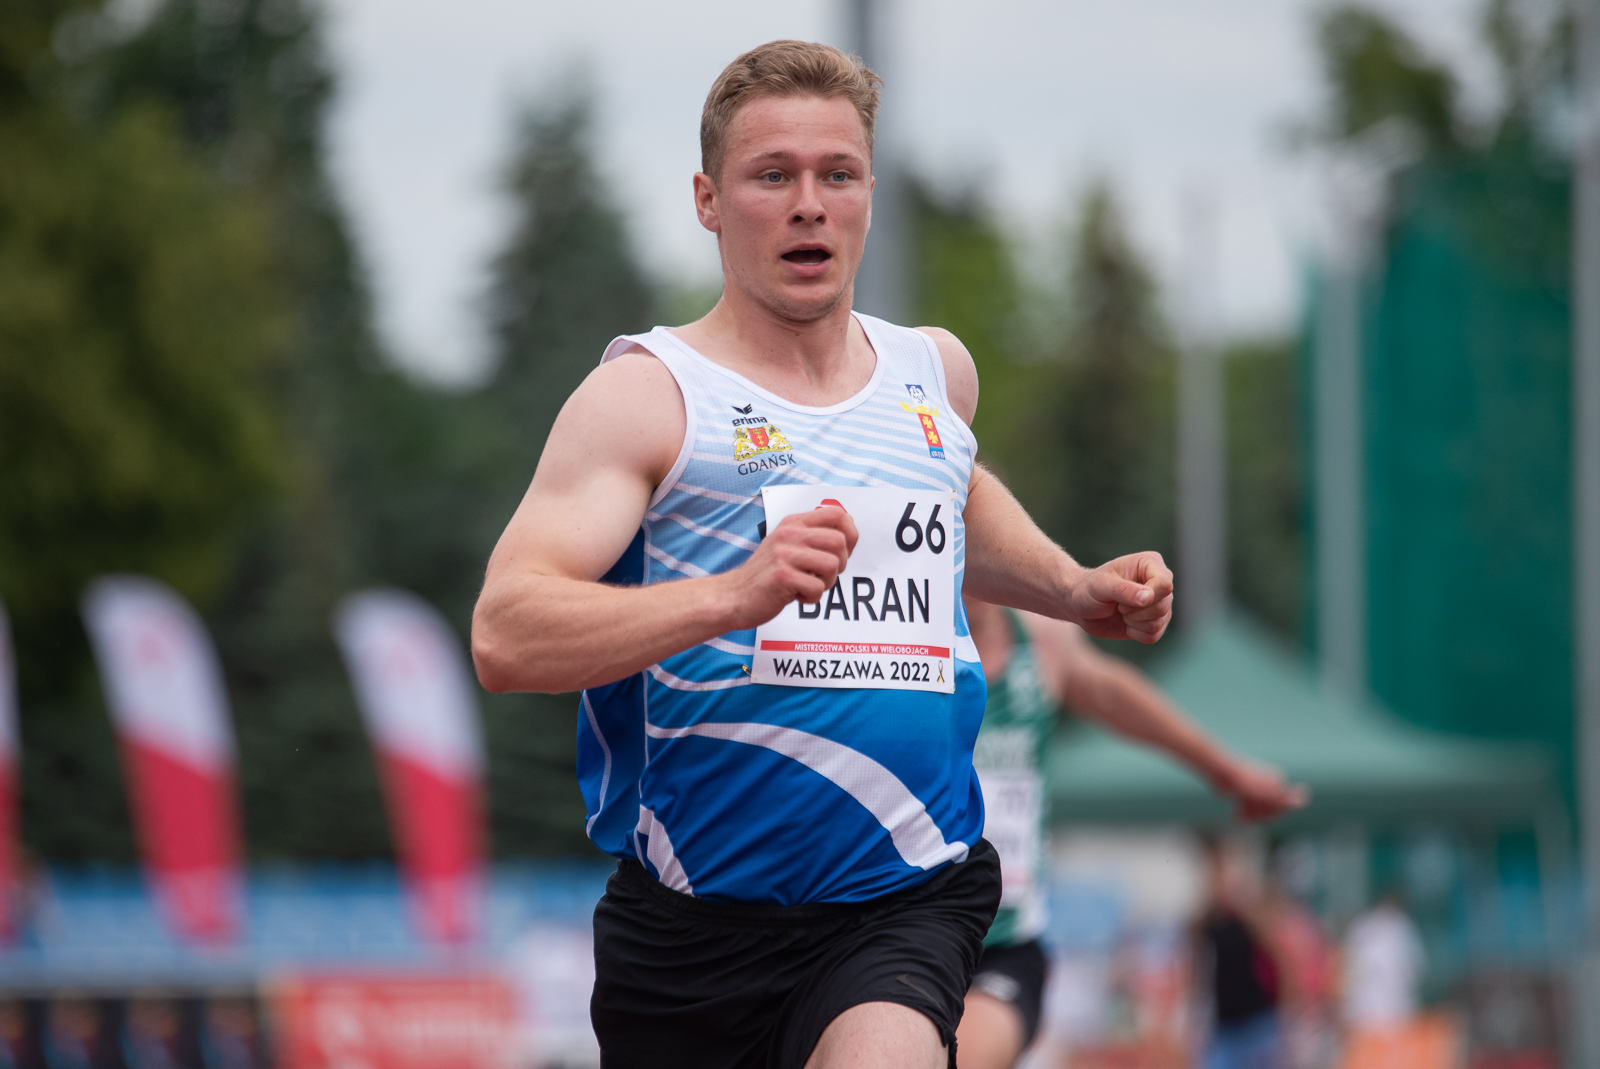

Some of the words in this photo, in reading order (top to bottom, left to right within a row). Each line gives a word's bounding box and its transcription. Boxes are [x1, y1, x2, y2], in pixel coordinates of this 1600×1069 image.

[732, 416, 768, 427] erima
[738, 454, 796, 476] GDAŃSK
[895, 502, 946, 555] 66
[794, 643, 843, 653] MISTRZOSTWA
[844, 644, 870, 654] POLSKI
[870, 645, 880, 654] W
[880, 645, 929, 656] WIELOBOJACH
[772, 658, 885, 680] WARSZAWA
[890, 661, 930, 682] 2022
